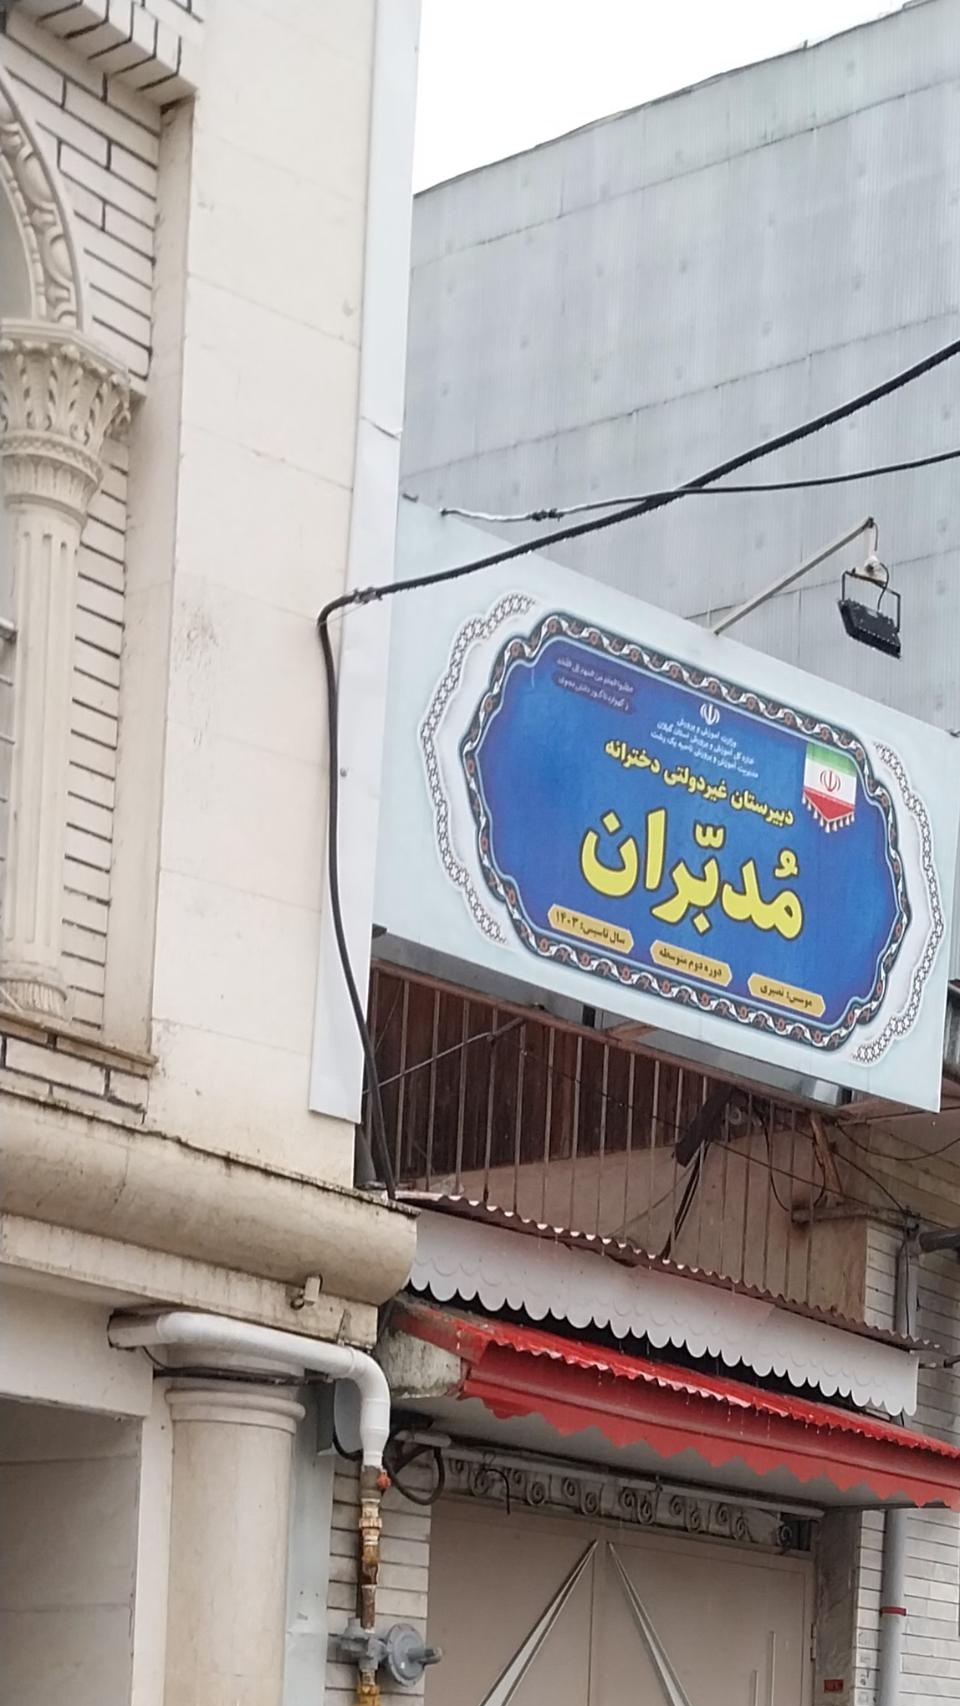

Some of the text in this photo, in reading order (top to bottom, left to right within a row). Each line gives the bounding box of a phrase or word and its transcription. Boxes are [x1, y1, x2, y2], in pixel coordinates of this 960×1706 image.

[605, 739, 661, 774] دخترانه
[731, 790, 795, 827] دبیرستان
[555, 911, 579, 927] ۱۴۰۳
[609, 931, 626, 944] سال
[659, 948, 722, 978] دوره دوم متوسطه
